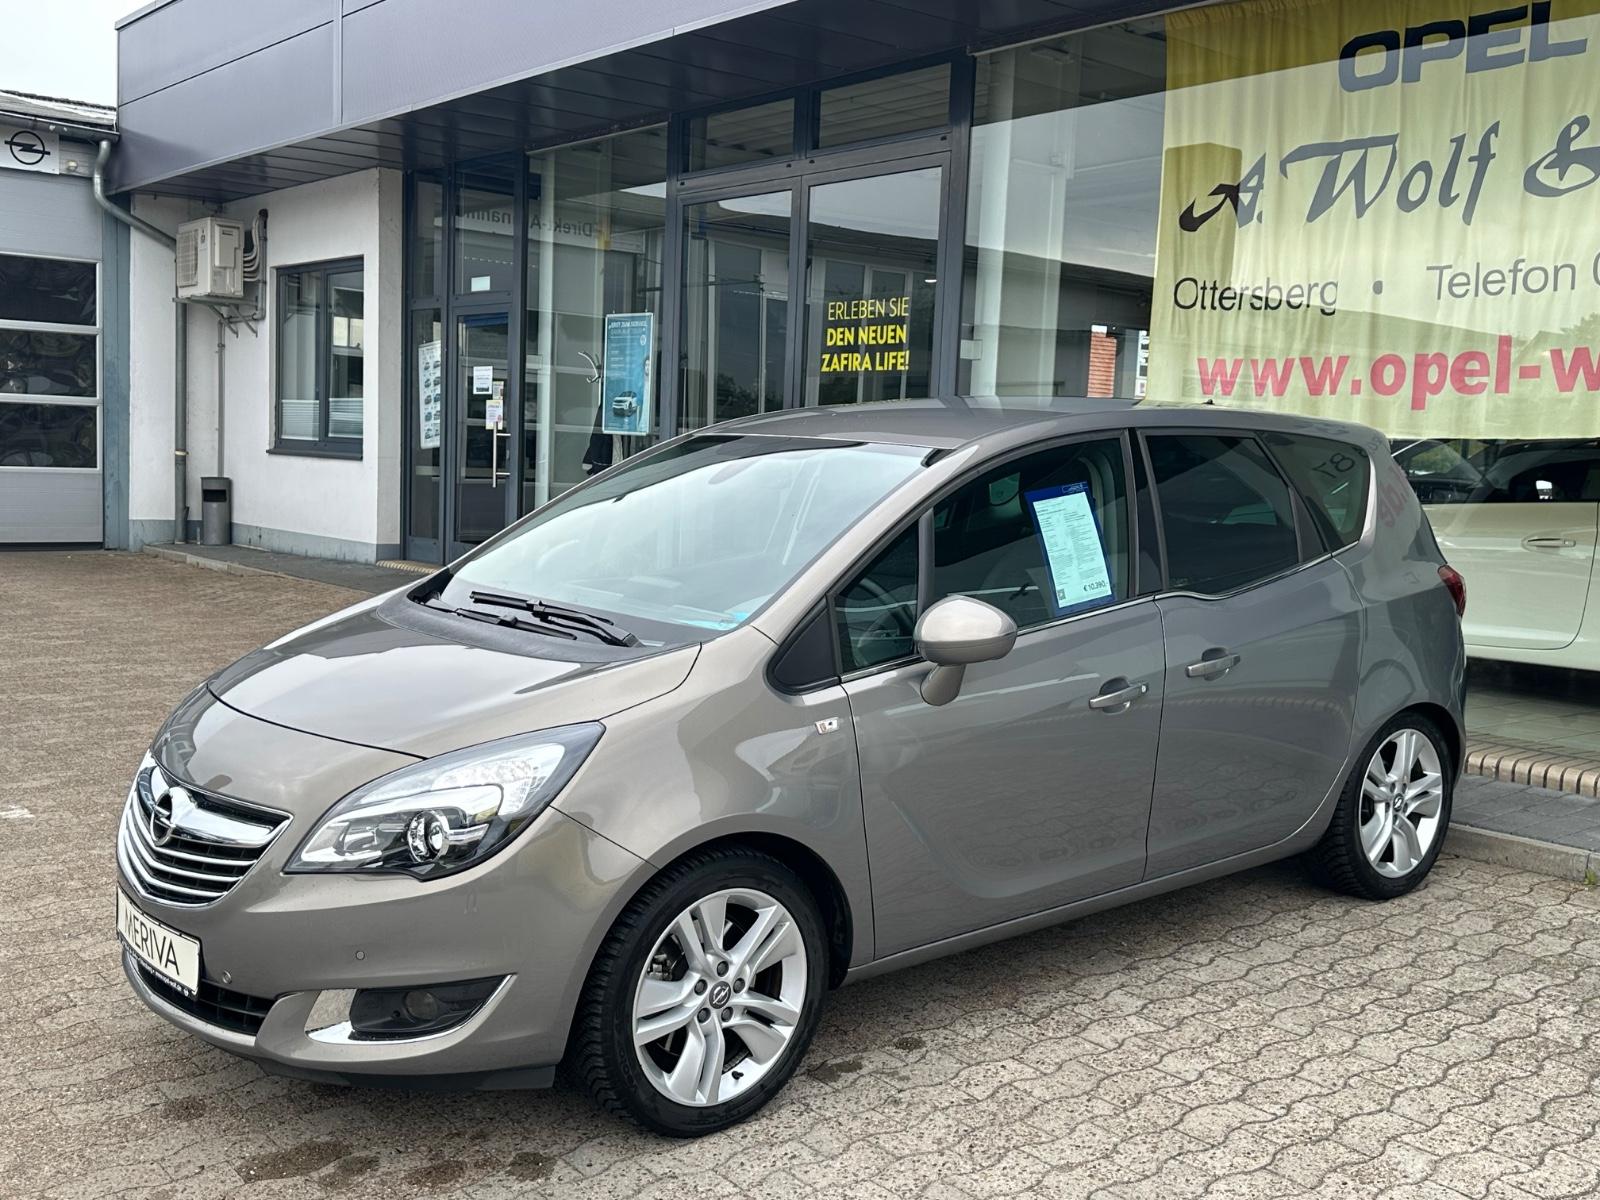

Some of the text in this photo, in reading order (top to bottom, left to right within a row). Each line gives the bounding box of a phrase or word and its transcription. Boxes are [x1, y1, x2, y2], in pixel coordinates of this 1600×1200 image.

[1338, 1, 1588, 93] OPEL
[1279, 120, 1501, 226] Wolf
[1523, 114, 1600, 198] &
[828, 296, 910, 320] ERLEBEN SIE
[1173, 277, 1339, 316] Ottersberg
[1426, 258, 1577, 301] Telefon
[821, 350, 910, 372] ZAFIRA LIFE!
[826, 324, 907, 347] DEN NEUEN
[1197, 334, 1600, 411] www.opel-w
[124, 903, 180, 976] MERIVA
